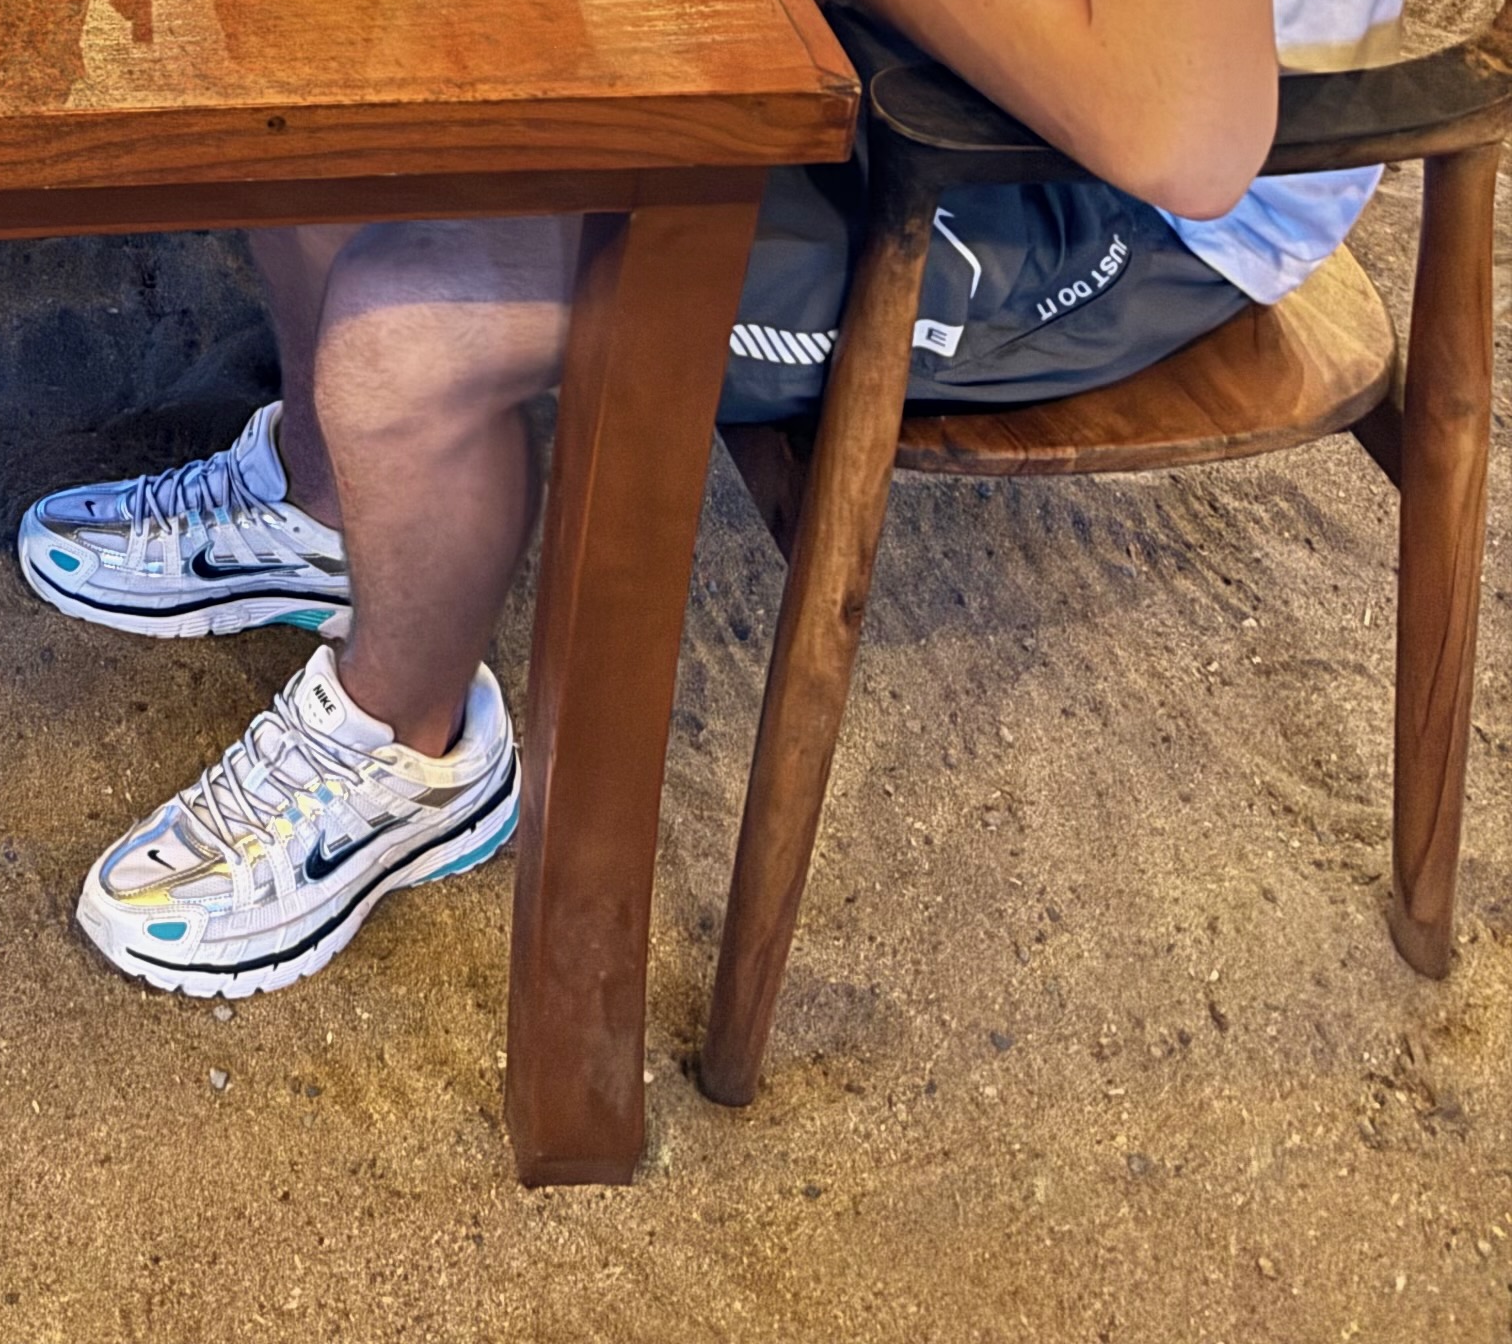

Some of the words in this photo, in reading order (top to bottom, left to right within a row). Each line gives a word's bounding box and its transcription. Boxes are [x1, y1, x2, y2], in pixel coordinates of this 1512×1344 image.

[1091, 234, 1128, 288] JUST
[1058, 280, 1093, 306] DO
[1036, 297, 1058, 321] IT
[313, 684, 336, 716] NIKE
